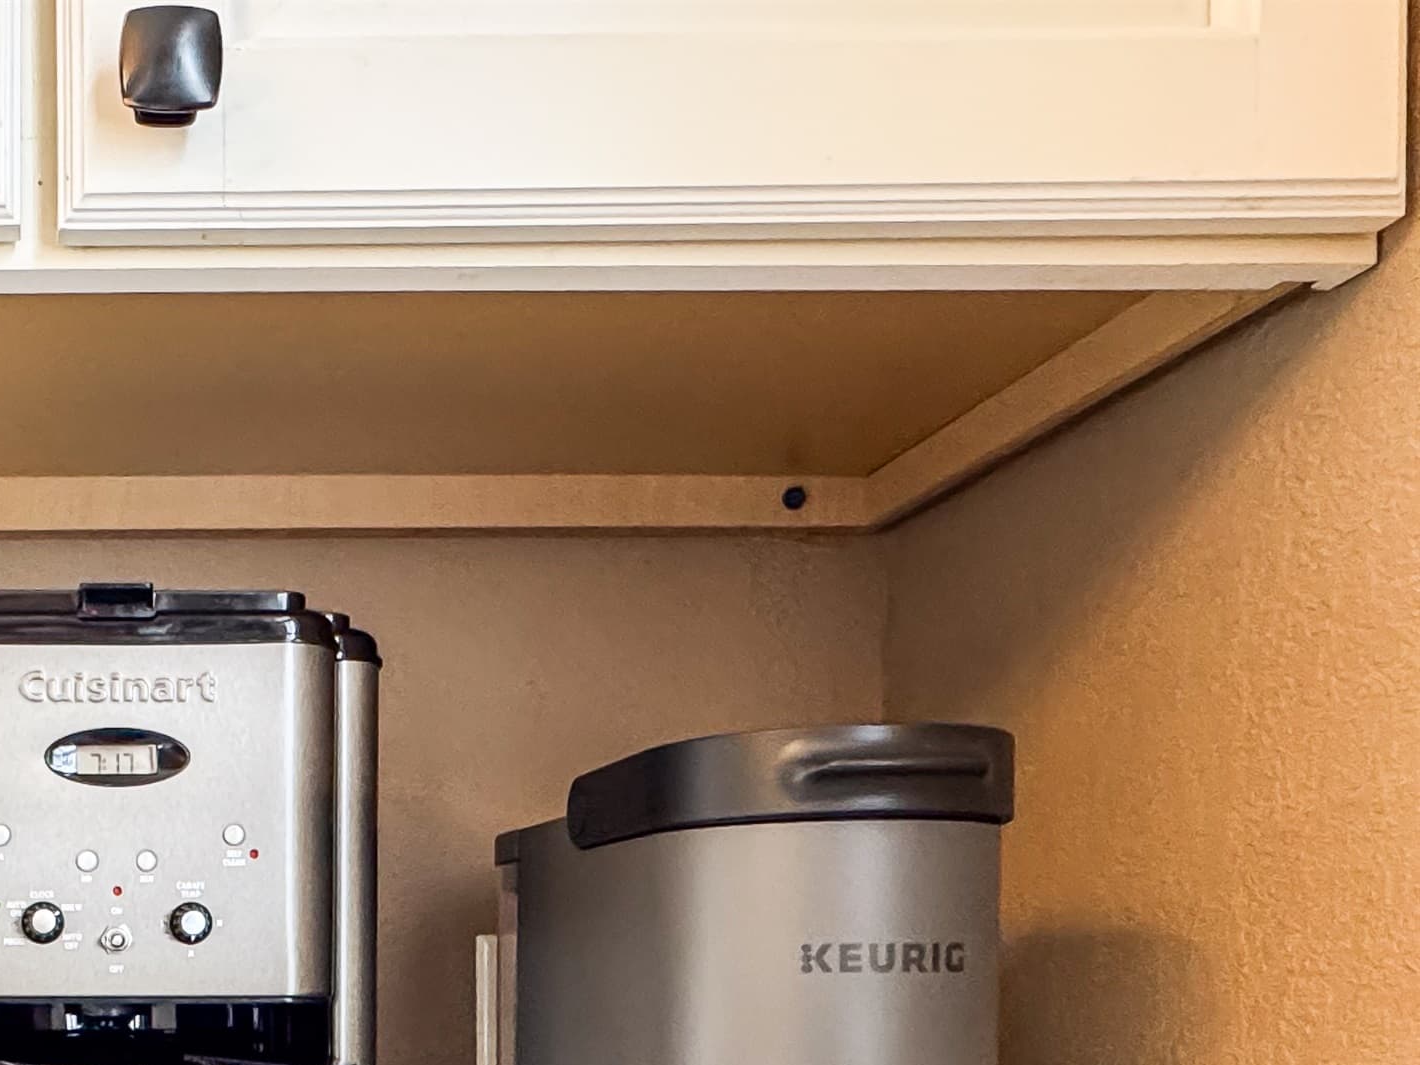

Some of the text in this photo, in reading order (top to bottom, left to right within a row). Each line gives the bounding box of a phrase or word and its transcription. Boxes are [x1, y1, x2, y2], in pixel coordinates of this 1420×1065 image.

[18, 669, 218, 703] Cuisinart
[90, 752, 134, 774] 7:17
[799, 942, 966, 974] KEURIG
